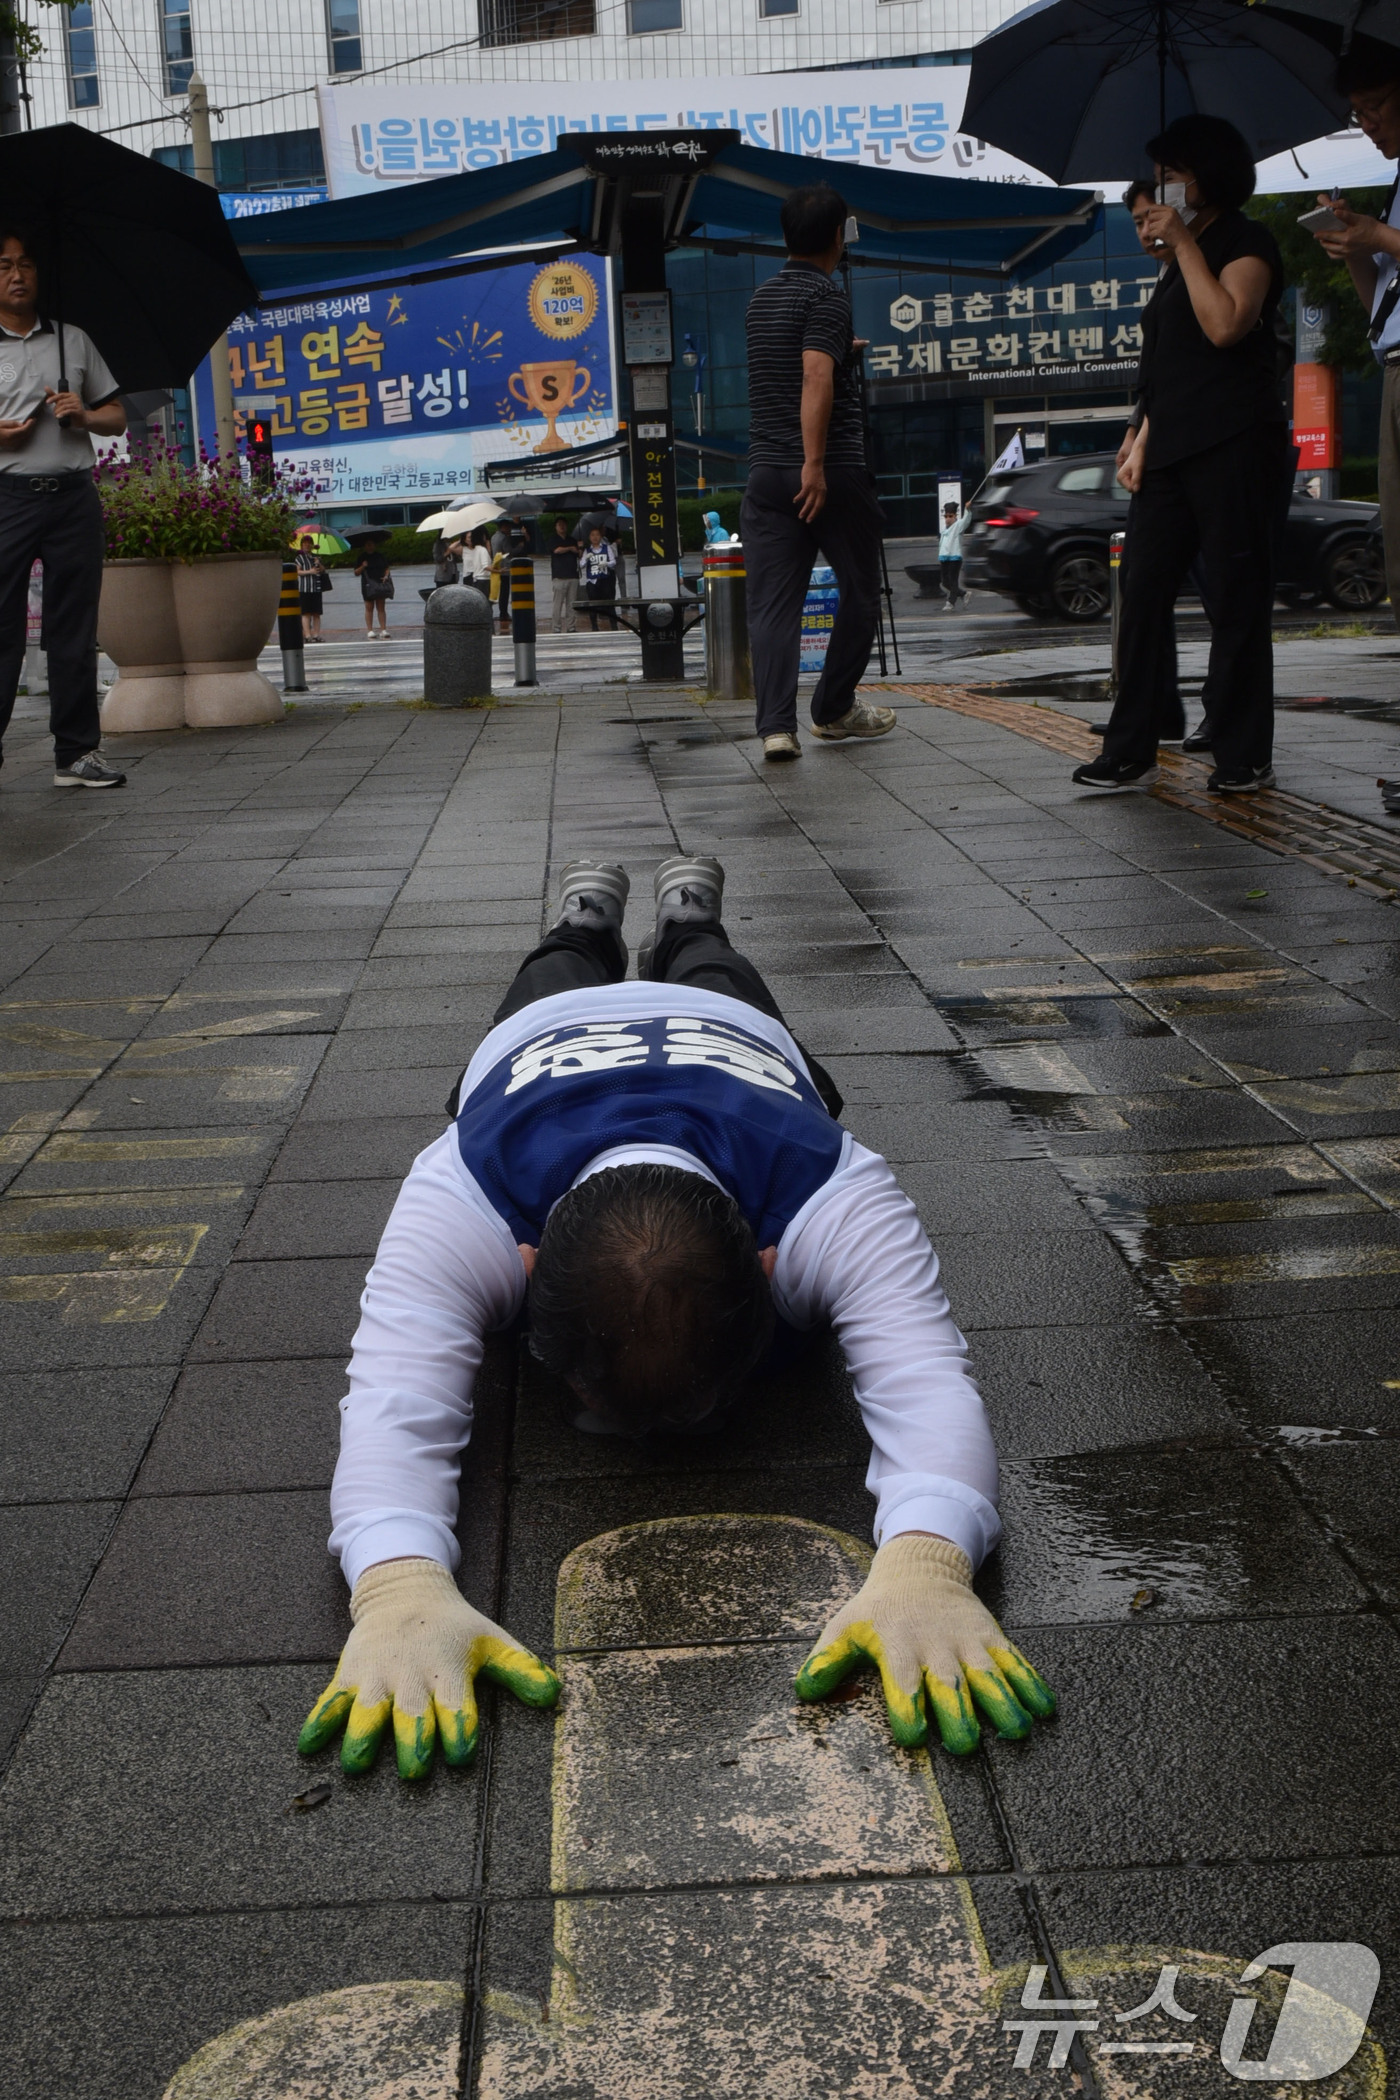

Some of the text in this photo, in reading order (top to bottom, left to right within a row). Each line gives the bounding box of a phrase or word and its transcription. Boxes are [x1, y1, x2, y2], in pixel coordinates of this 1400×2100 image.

[672, 139, 708, 162] 순천
[551, 286, 575, 297] 사업비
[261, 294, 371, 329] 국립대학육성사업
[542, 296, 585, 315] 120억
[554, 316, 574, 327] 확보!
[301, 321, 386, 382] 연속
[868, 322, 1144, 377] 국제문화컨벤션
[968, 359, 1139, 382] International Cultural Conventio
[378, 368, 470, 425] 달성!
[541, 375, 559, 402] S
[297, 457, 353, 475] 교육혁신,
[349, 474, 401, 493] 대한민국
[405, 468, 471, 490] 고등교육의
